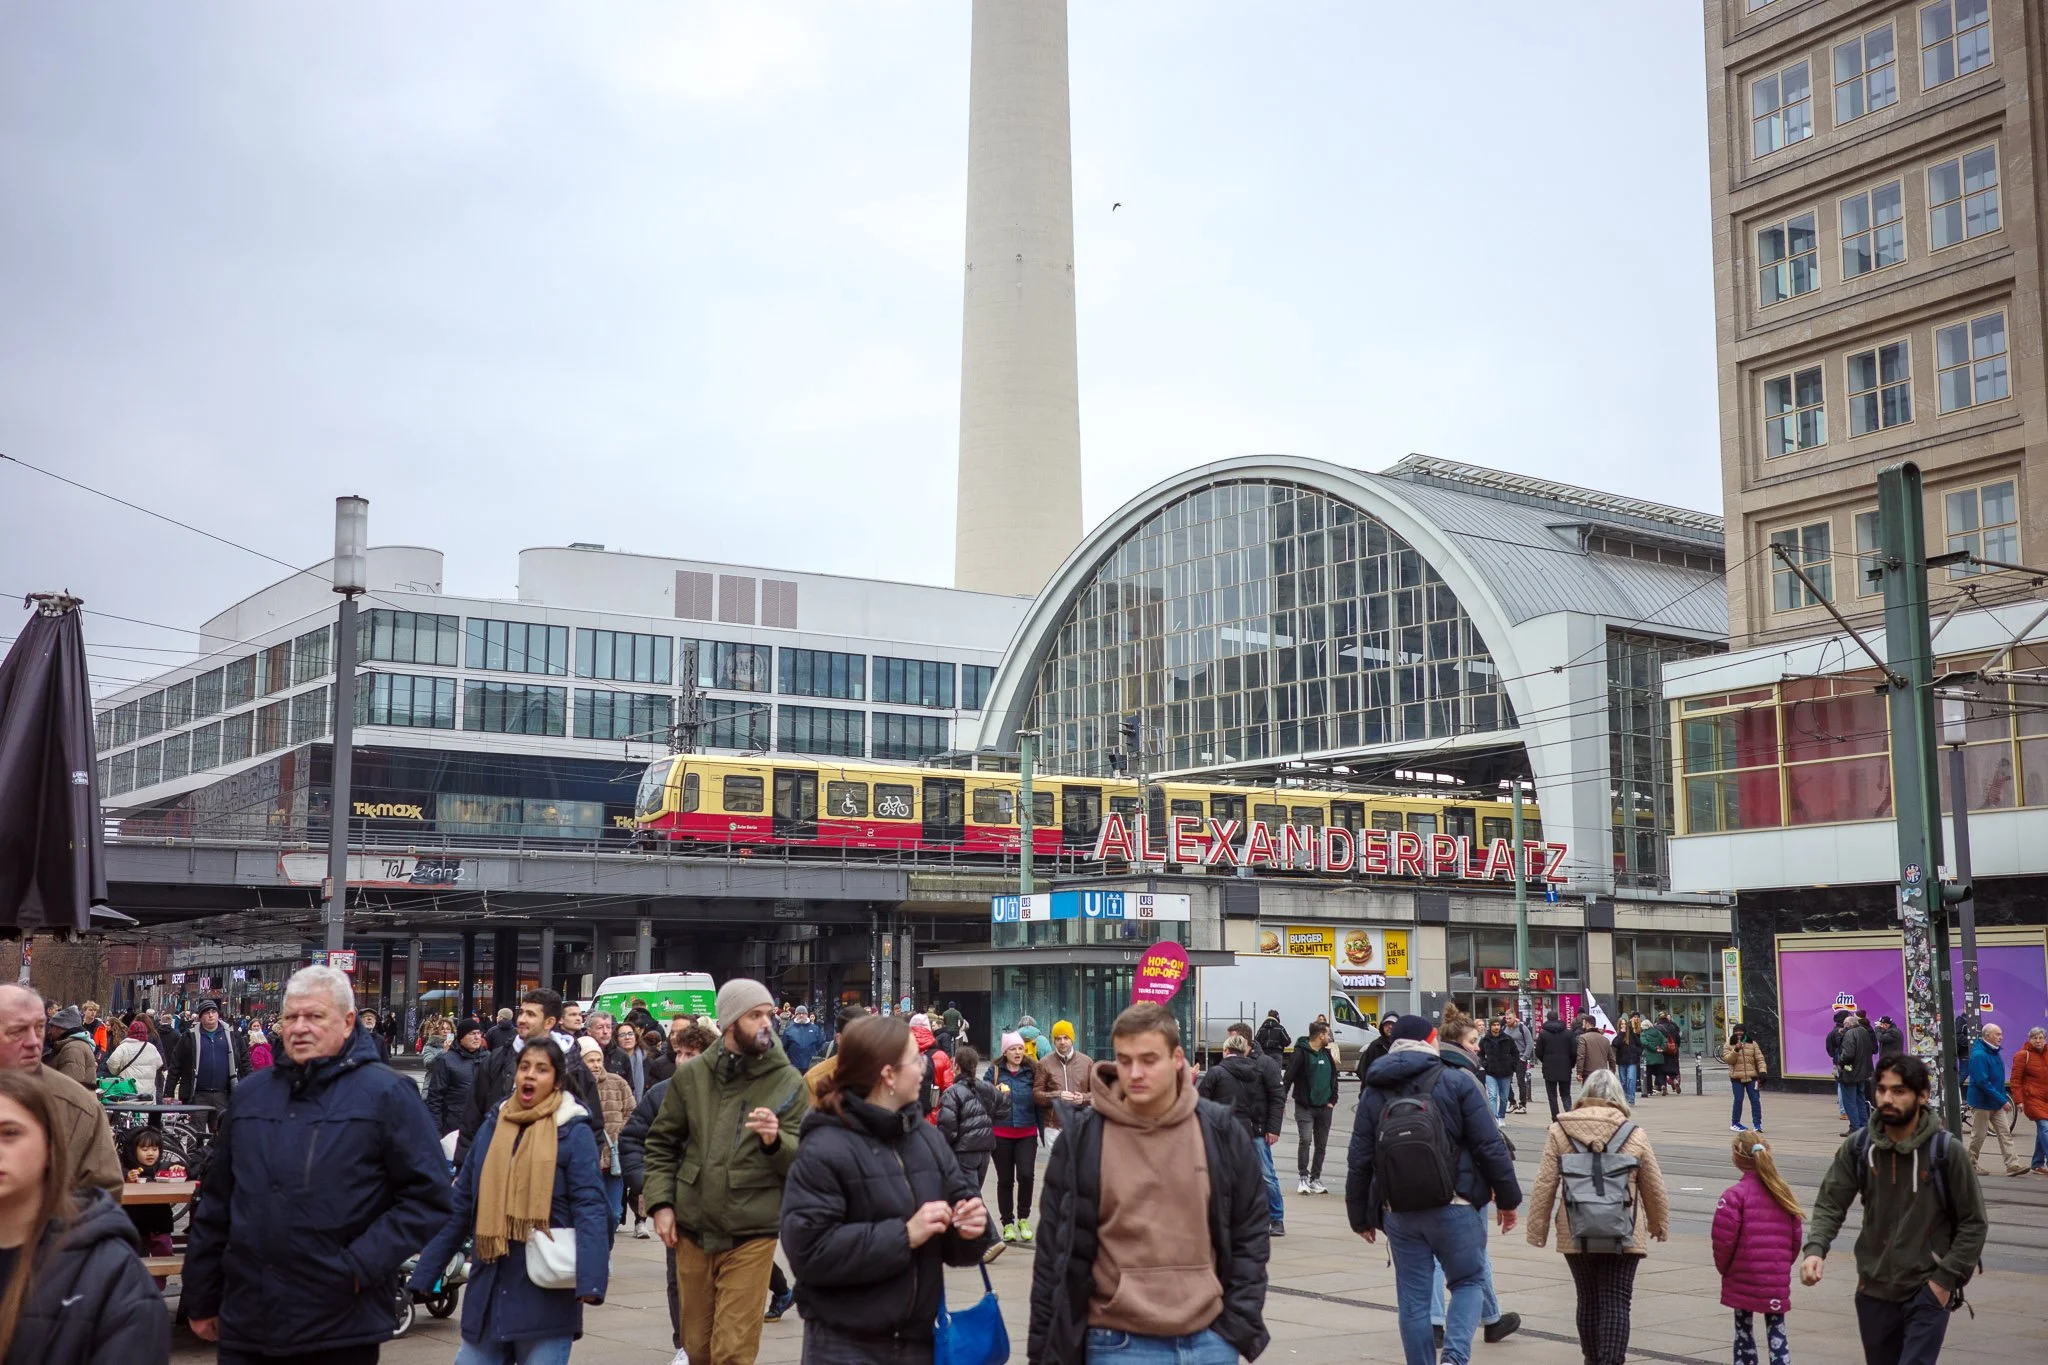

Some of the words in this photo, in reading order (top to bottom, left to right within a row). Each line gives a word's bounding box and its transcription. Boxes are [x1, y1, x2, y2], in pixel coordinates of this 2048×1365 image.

[1092, 811, 1570, 884] ALEXANDERPLATZ
[1084, 892, 1101, 917] U
[1140, 896, 1153, 905] U8
[994, 898, 1005, 921] U
[1022, 910, 1030, 919] U5
[1140, 908, 1153, 917] U5
[1290, 934, 1323, 944] BURGER
[1290, 944, 1305, 953] FÜR
[1305, 943, 1333, 953] MITTE?
[1387, 949, 1406, 957] LIEBE
[1147, 956, 1184, 970] HOP-ON
[1387, 957, 1399, 965] ES!
[1142, 966, 1181, 980] HOP-OFF
[1836, 991, 1854, 1005] dm
